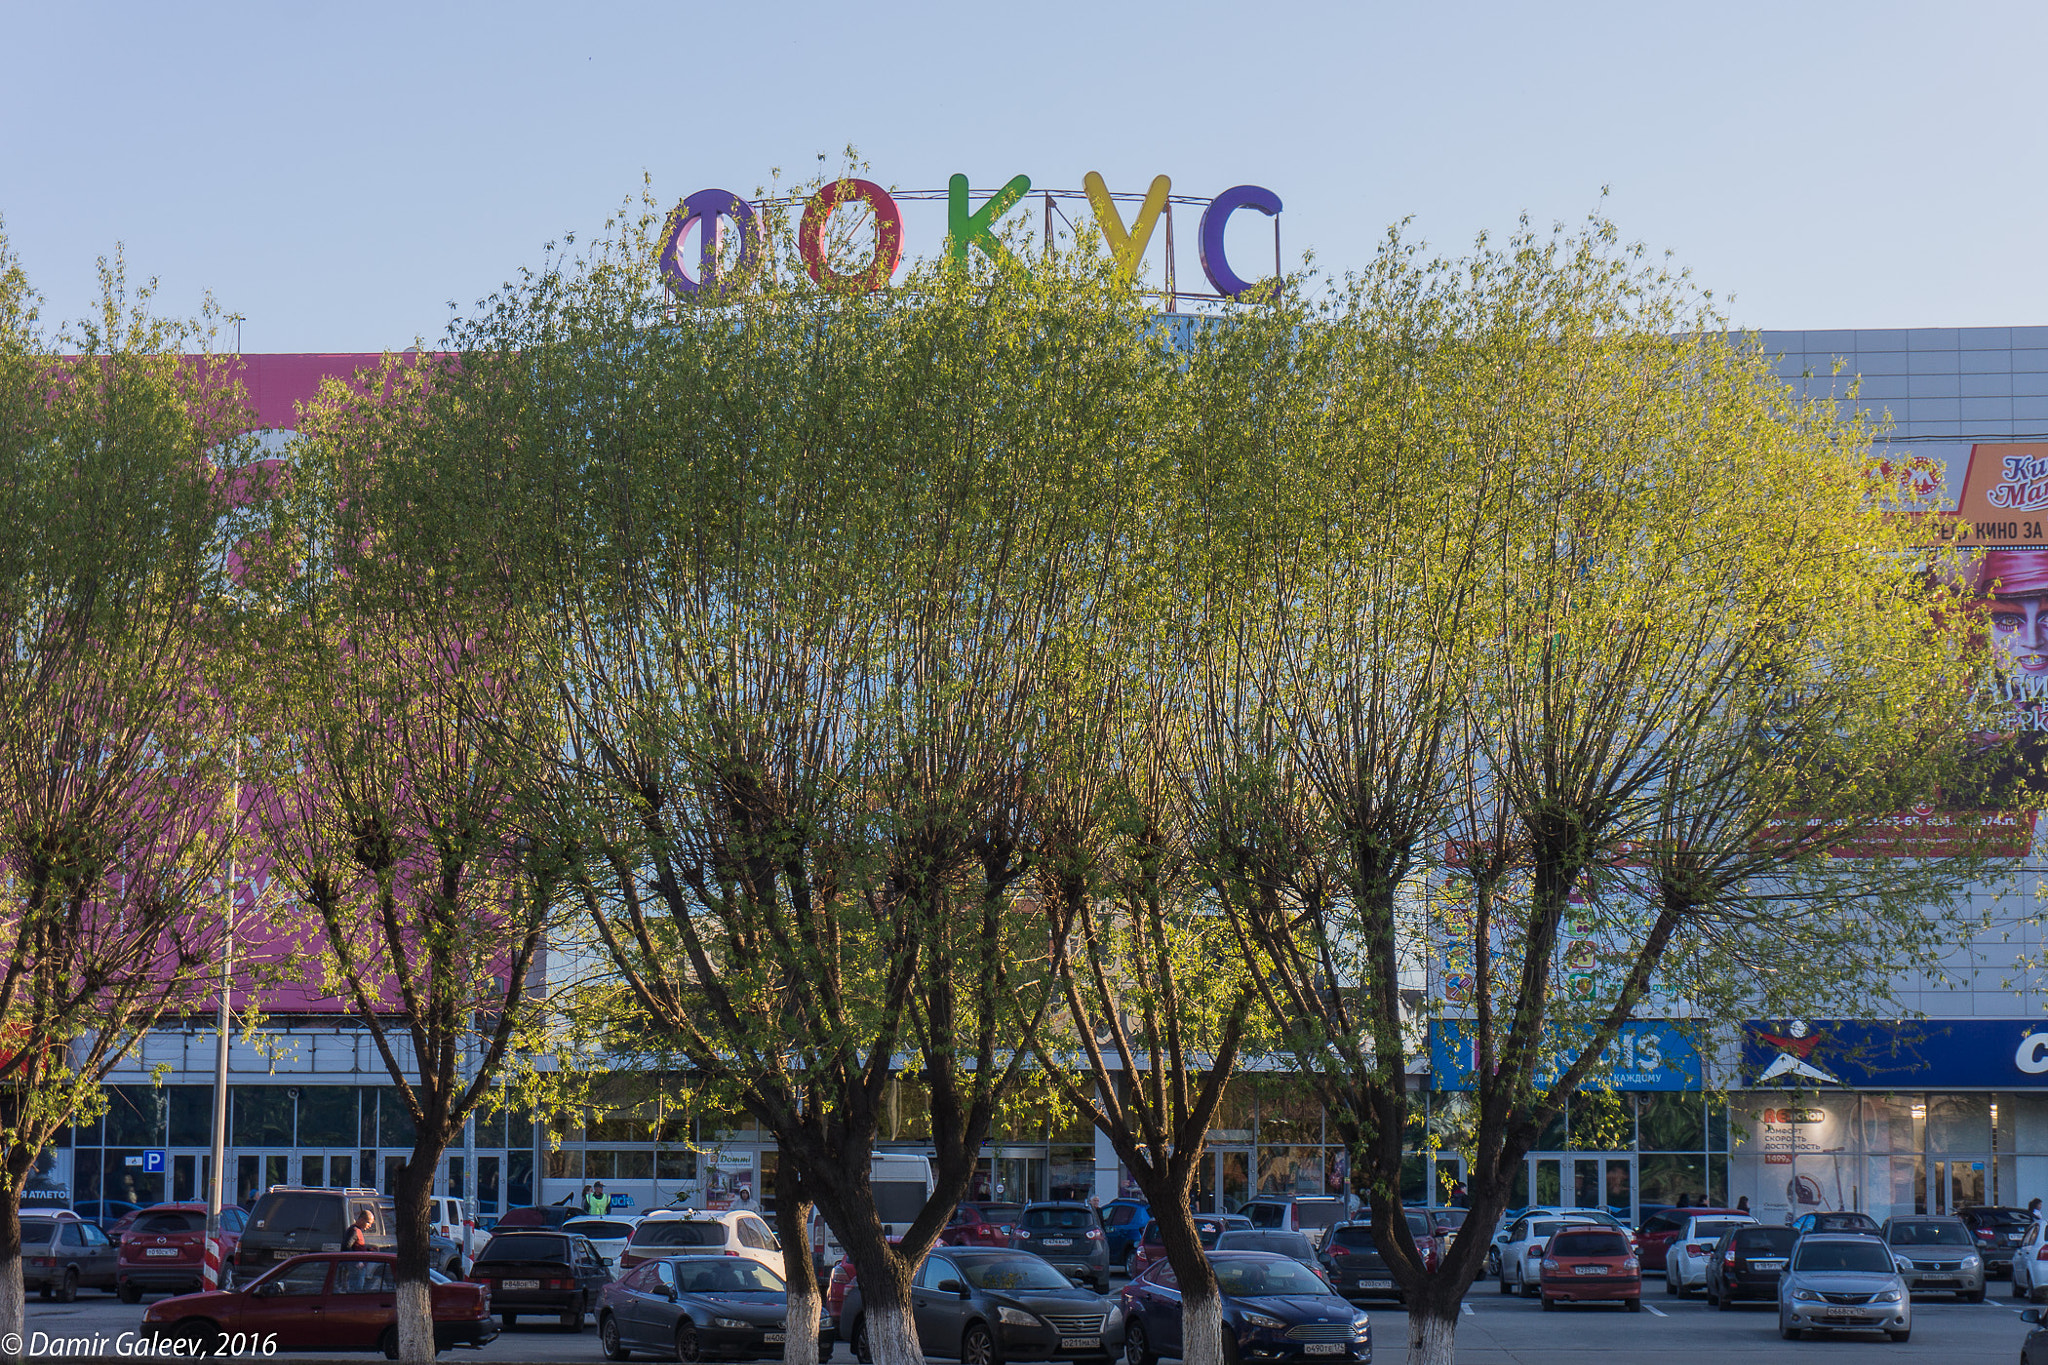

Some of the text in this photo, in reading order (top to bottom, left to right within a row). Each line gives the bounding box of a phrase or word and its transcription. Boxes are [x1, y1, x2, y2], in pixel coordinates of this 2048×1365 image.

[659, 170, 1284, 302] ФОКУС
[1975, 522, 2018, 540] КИНО
[2022, 521, 2044, 540] ЗА
[148, 1153, 161, 1171] P
